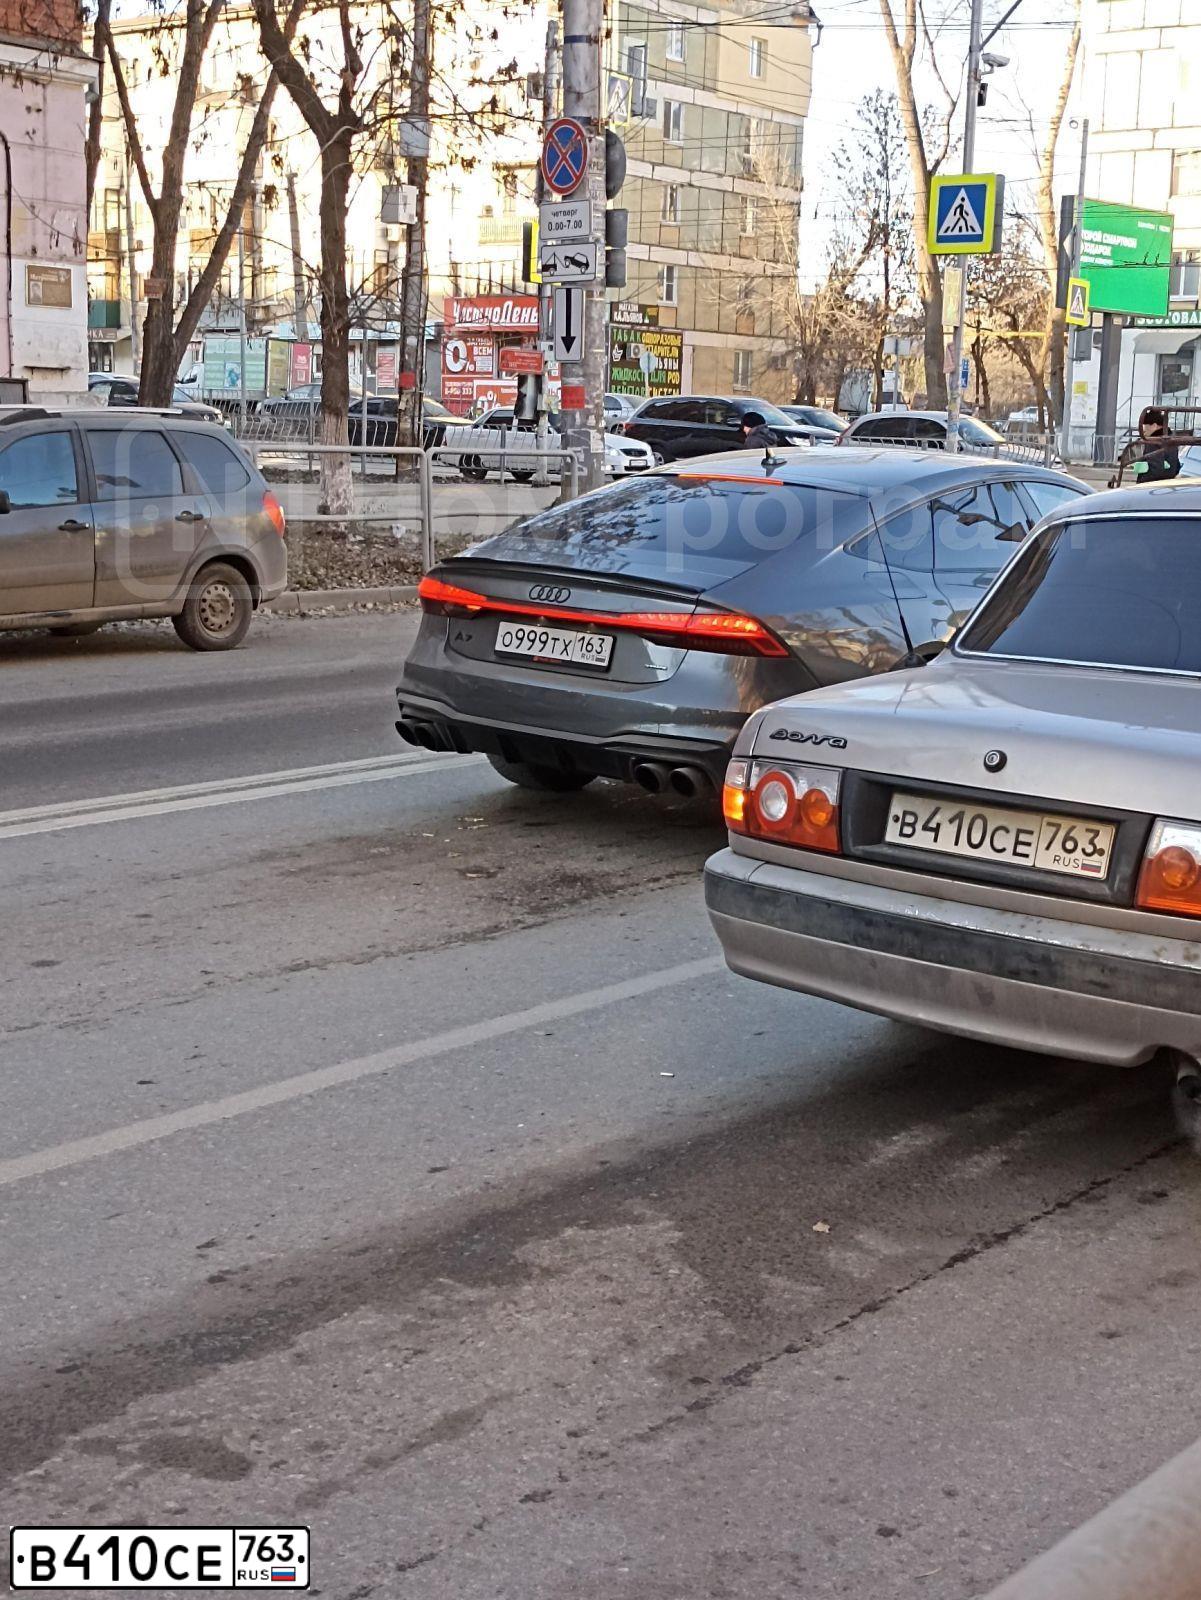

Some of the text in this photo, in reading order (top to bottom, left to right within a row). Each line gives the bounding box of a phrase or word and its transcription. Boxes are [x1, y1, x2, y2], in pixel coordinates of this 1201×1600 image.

[551, 208, 578, 218] четверг
[547, 219, 583, 232] 0.00-7.00
[453, 300, 552, 324] ЧестноДень
[613, 328, 641, 343] ТАБАК
[473, 346, 493, 356] ВСЕМ
[612, 367, 646, 382] ЖИДКОСТ
[577, 635, 605, 655] 163
[1044, 821, 1100, 857] 763
[1052, 854, 1081, 869] RUS
